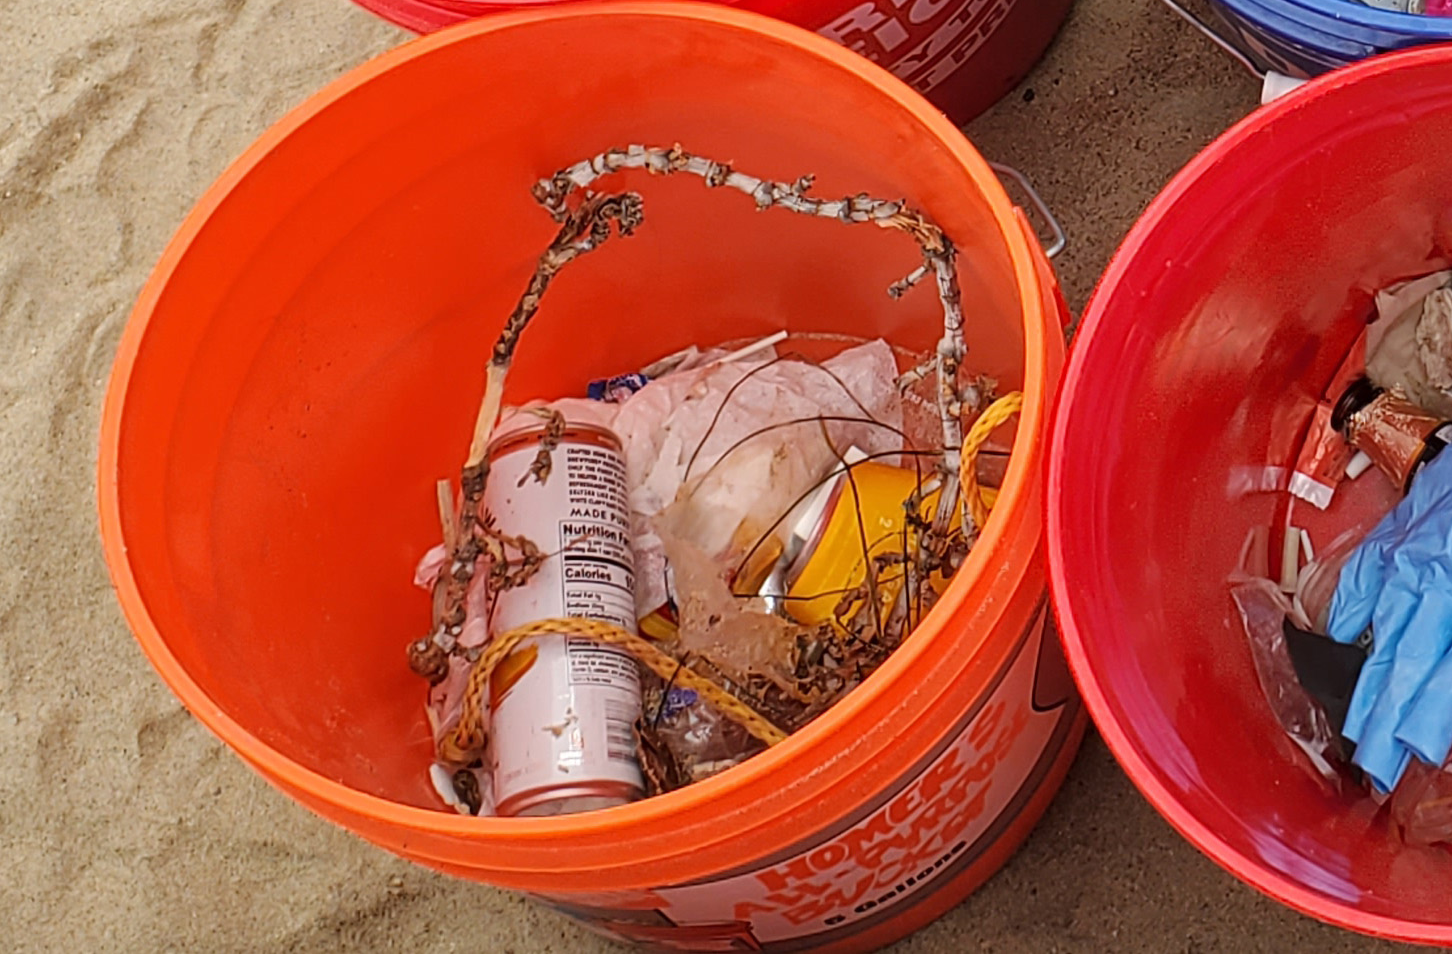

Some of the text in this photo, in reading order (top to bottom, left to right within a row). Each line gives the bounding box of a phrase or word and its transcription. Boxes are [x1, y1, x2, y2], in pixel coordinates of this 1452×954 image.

[570, 508, 607, 520] MADE
[563, 524, 617, 541] Nutrition
[565, 567, 612, 582] Calories
[781, 778, 993, 926] BUCKET
[854, 840, 967, 913] Gallons
